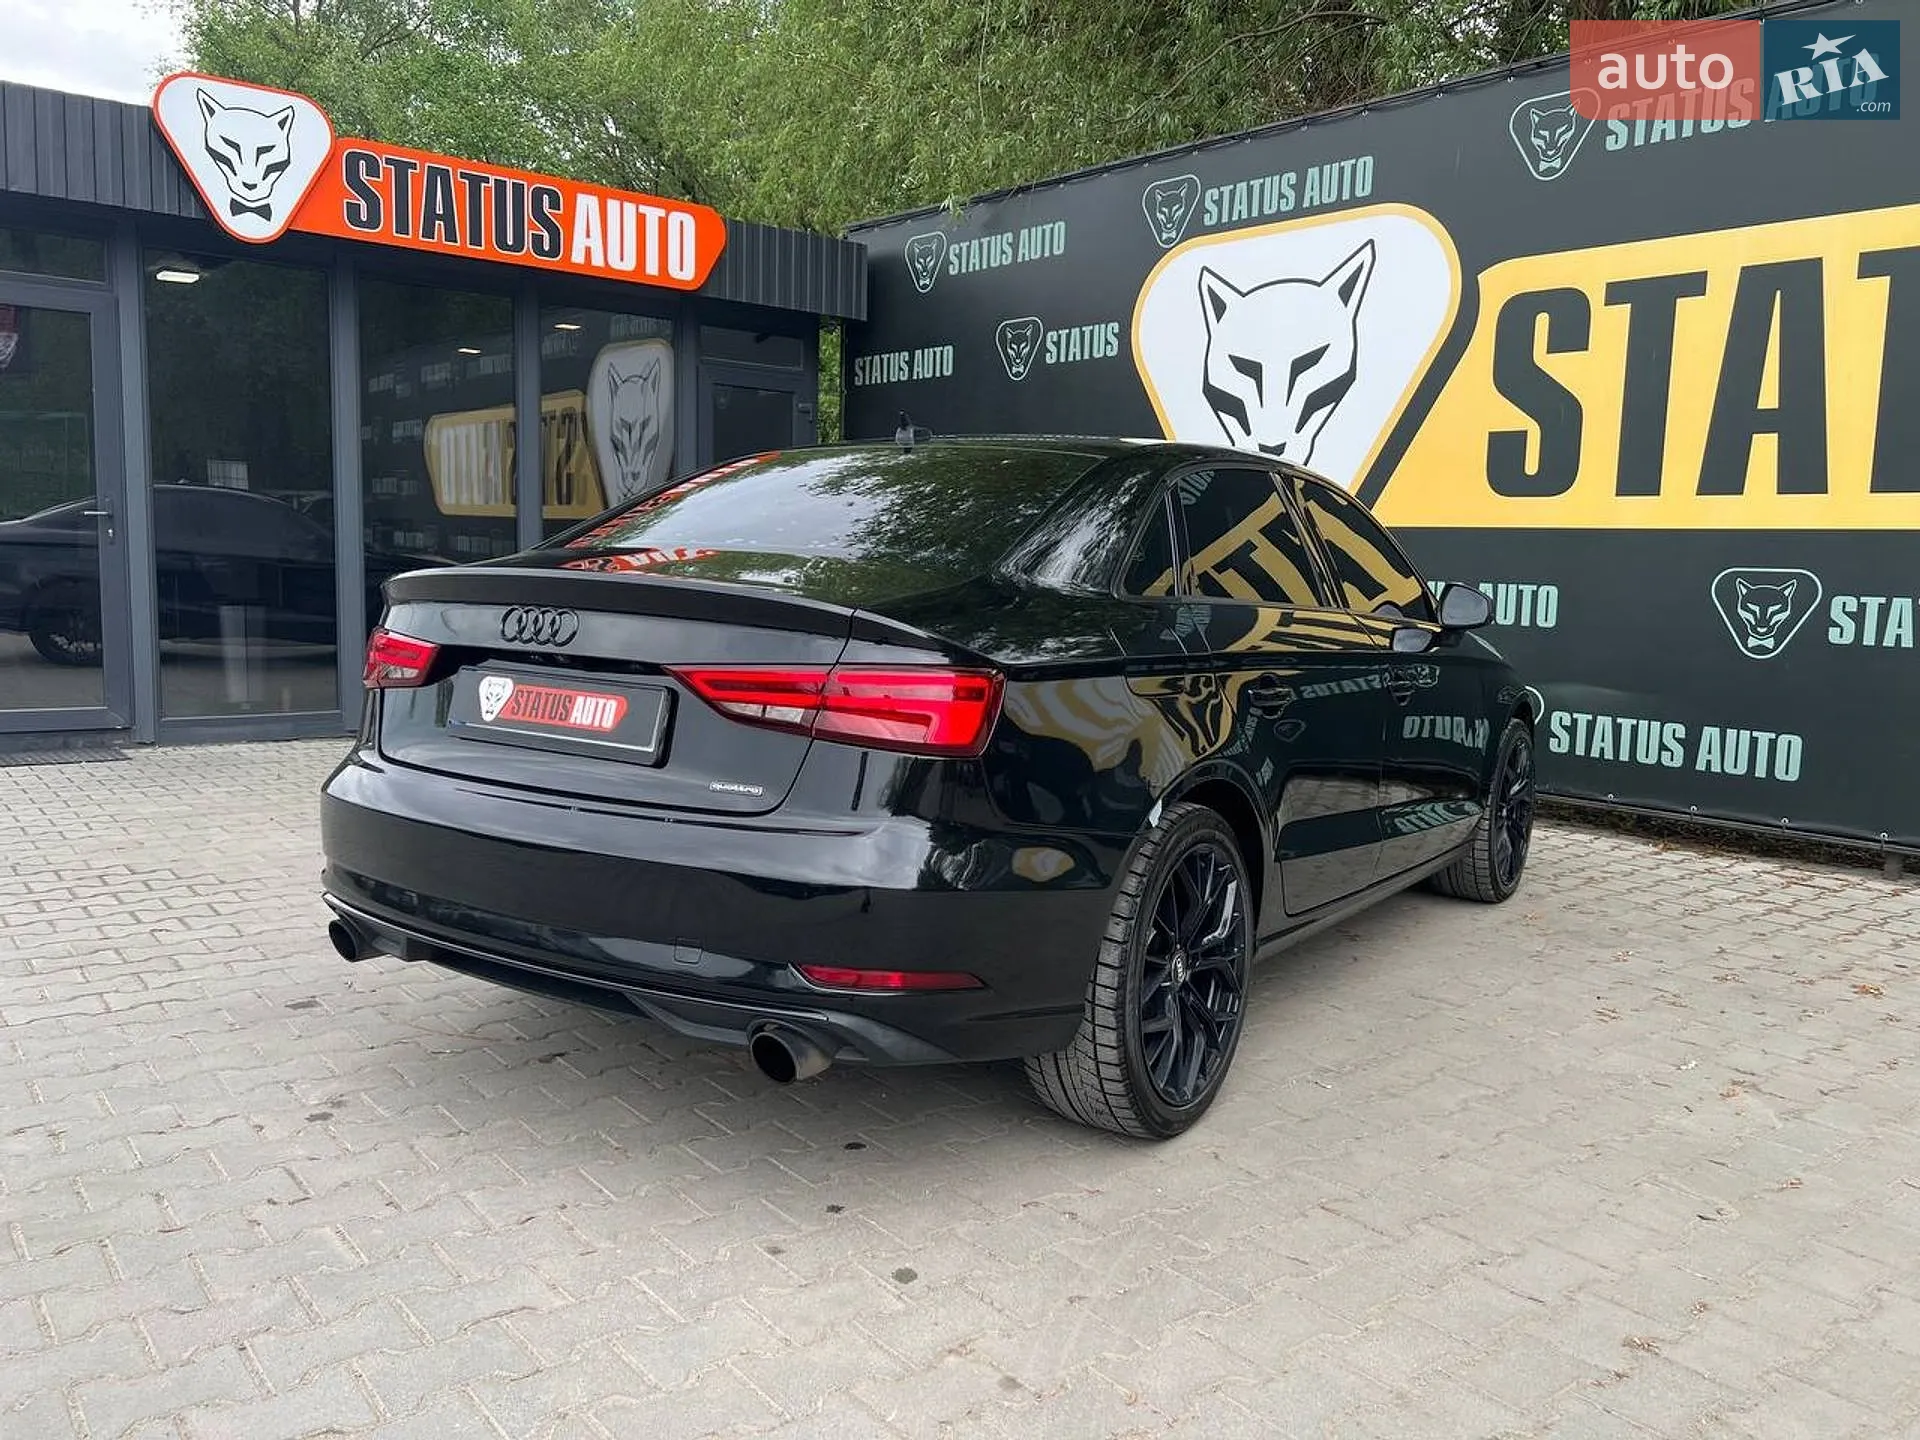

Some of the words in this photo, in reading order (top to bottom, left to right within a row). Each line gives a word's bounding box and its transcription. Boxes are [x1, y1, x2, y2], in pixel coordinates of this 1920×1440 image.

[1605, 78, 1754, 151] STATUS
[343, 149, 563, 261] STATUS
[571, 193, 697, 283] AUTO
[1203, 172, 1296, 226] STATUS
[1302, 155, 1374, 209] AUTO
[948, 233, 1013, 276] STATUS
[1017, 221, 1066, 263] AUTO
[854, 350, 909, 386] STATUS
[912, 345, 954, 380] AUTO
[1045, 322, 1119, 365] STATUS
[1828, 595, 1920, 648] STA
[512, 689, 573, 721] STATUS
[569, 695, 617, 729] AUTO
[1549, 711, 1685, 768] STATUS
[1696, 726, 1802, 782] AUTO
